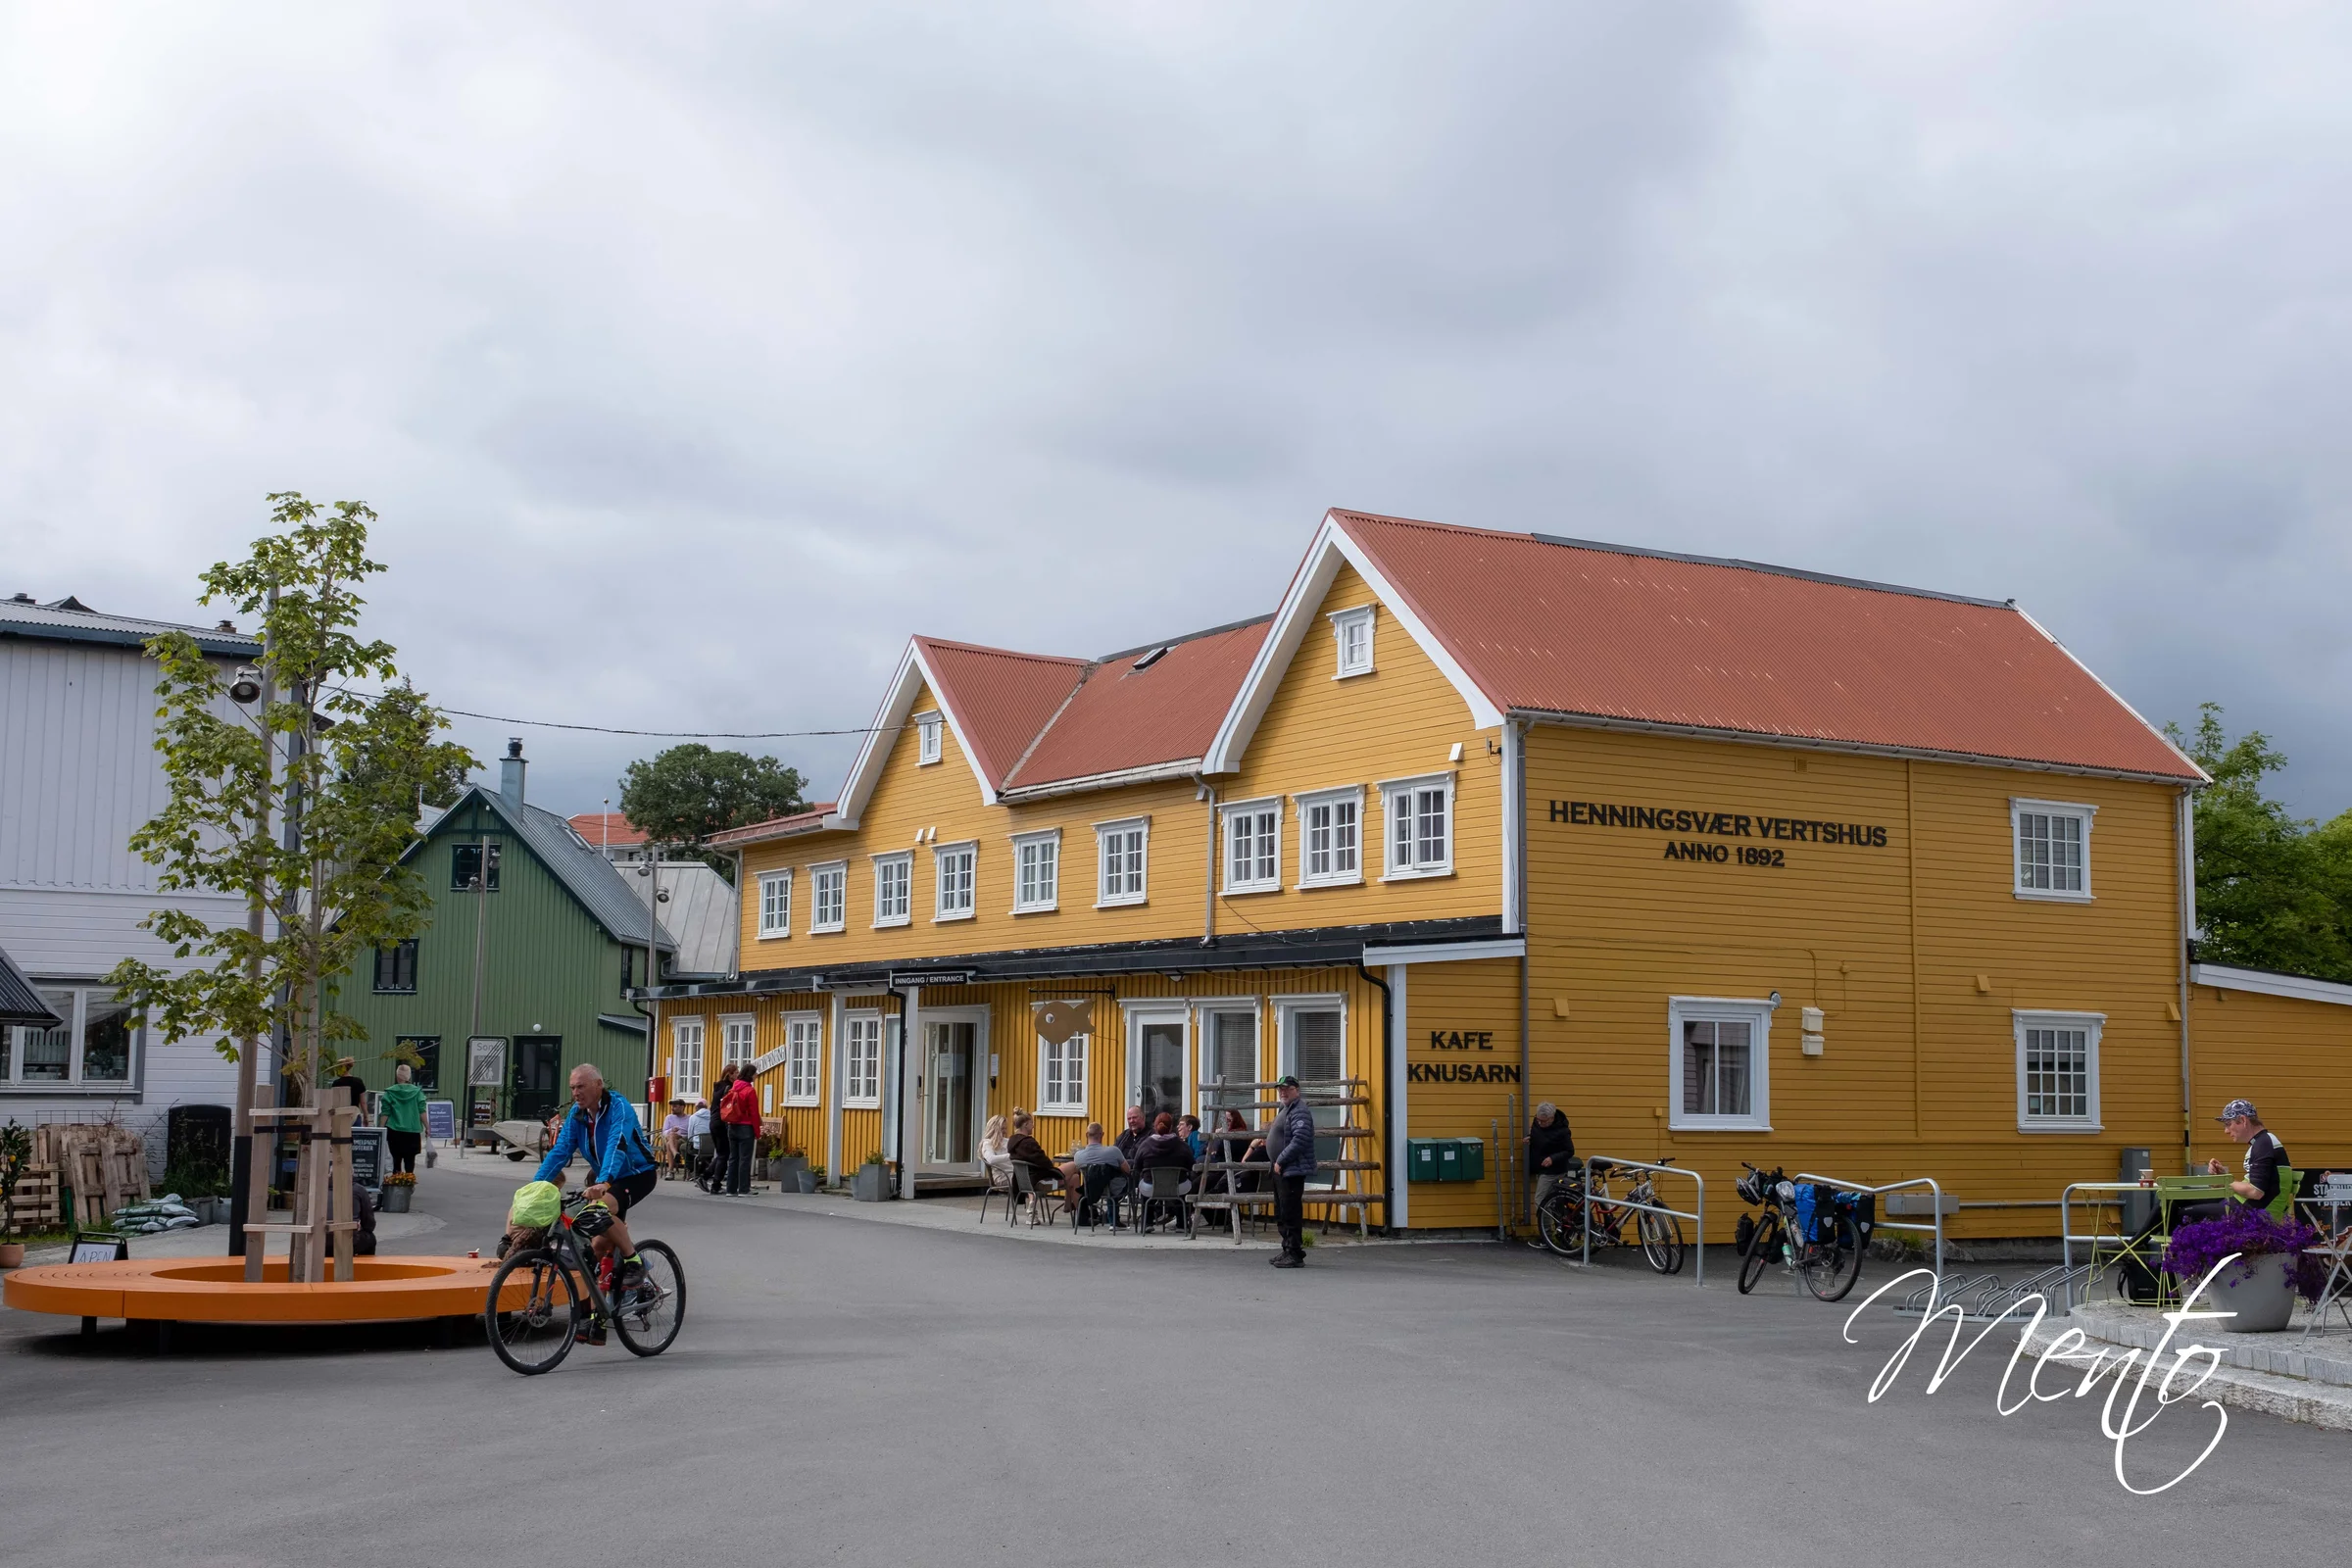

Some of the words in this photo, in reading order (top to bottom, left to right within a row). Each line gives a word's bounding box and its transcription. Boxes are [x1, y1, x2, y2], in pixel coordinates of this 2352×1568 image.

[1549, 800, 1752, 837] HENNINGSVÆR
[1755, 816, 1887, 848] VERTSHUS
[1664, 841, 1730, 863] ANNO
[1736, 846, 1786, 868] 1892
[1431, 1031, 1494, 1051] KAFE
[1407, 1063, 1522, 1084] KNUSARN
